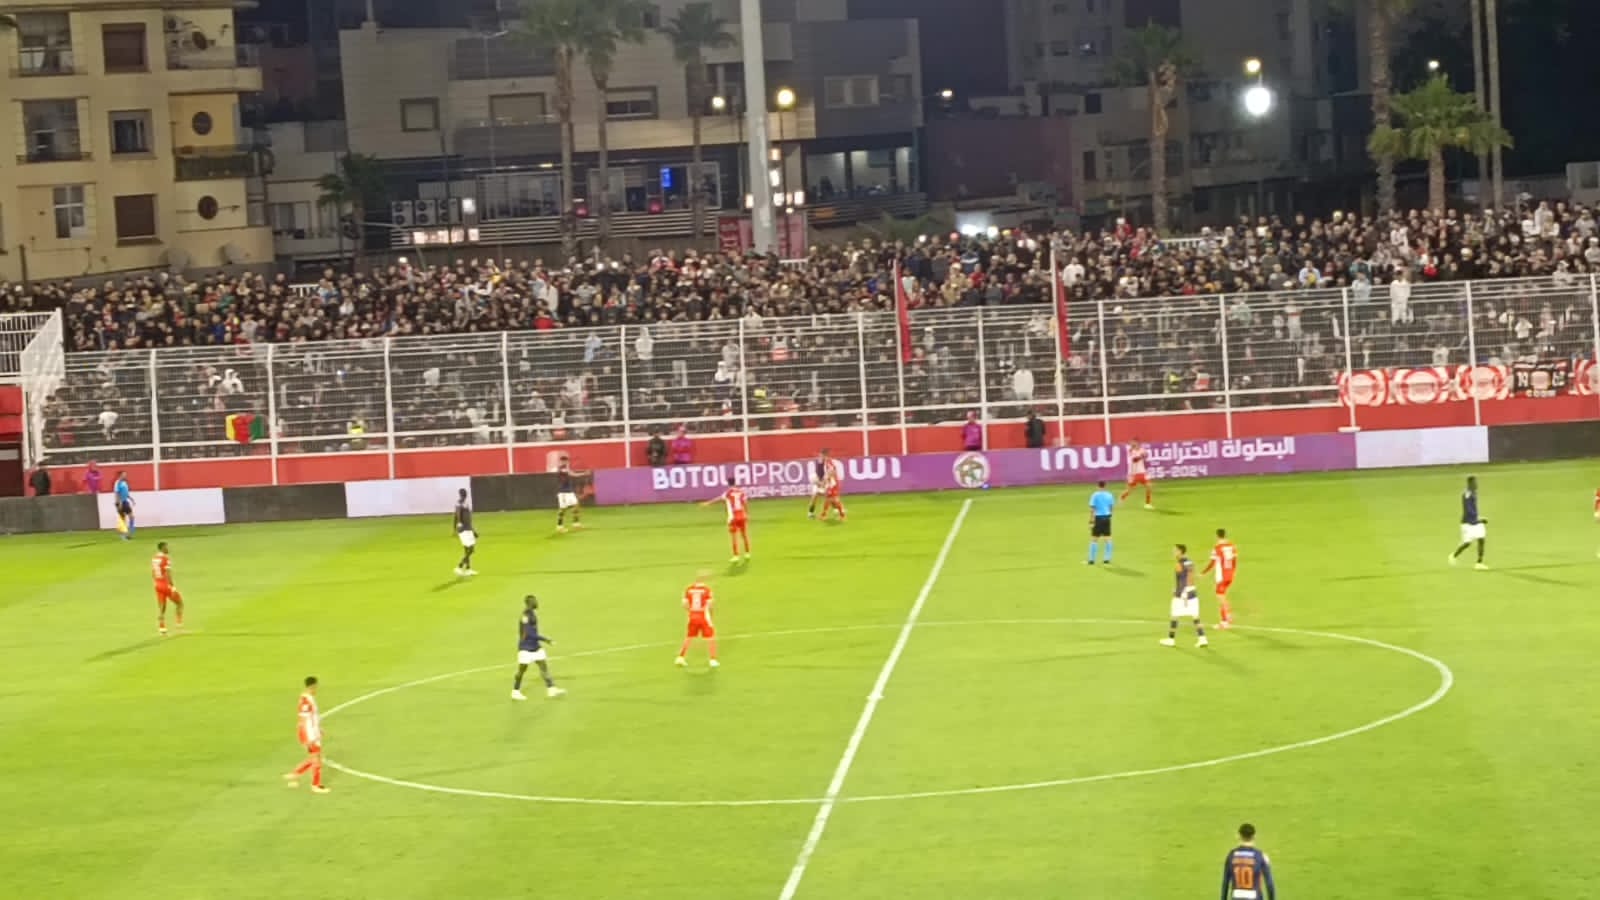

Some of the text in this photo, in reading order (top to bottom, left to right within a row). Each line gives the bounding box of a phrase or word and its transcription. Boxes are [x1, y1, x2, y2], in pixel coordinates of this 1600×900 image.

[1221, 435, 1297, 462] البطولة
[1147, 465, 1208, 479] 25-2024
[1233, 865, 1254, 889] 10
